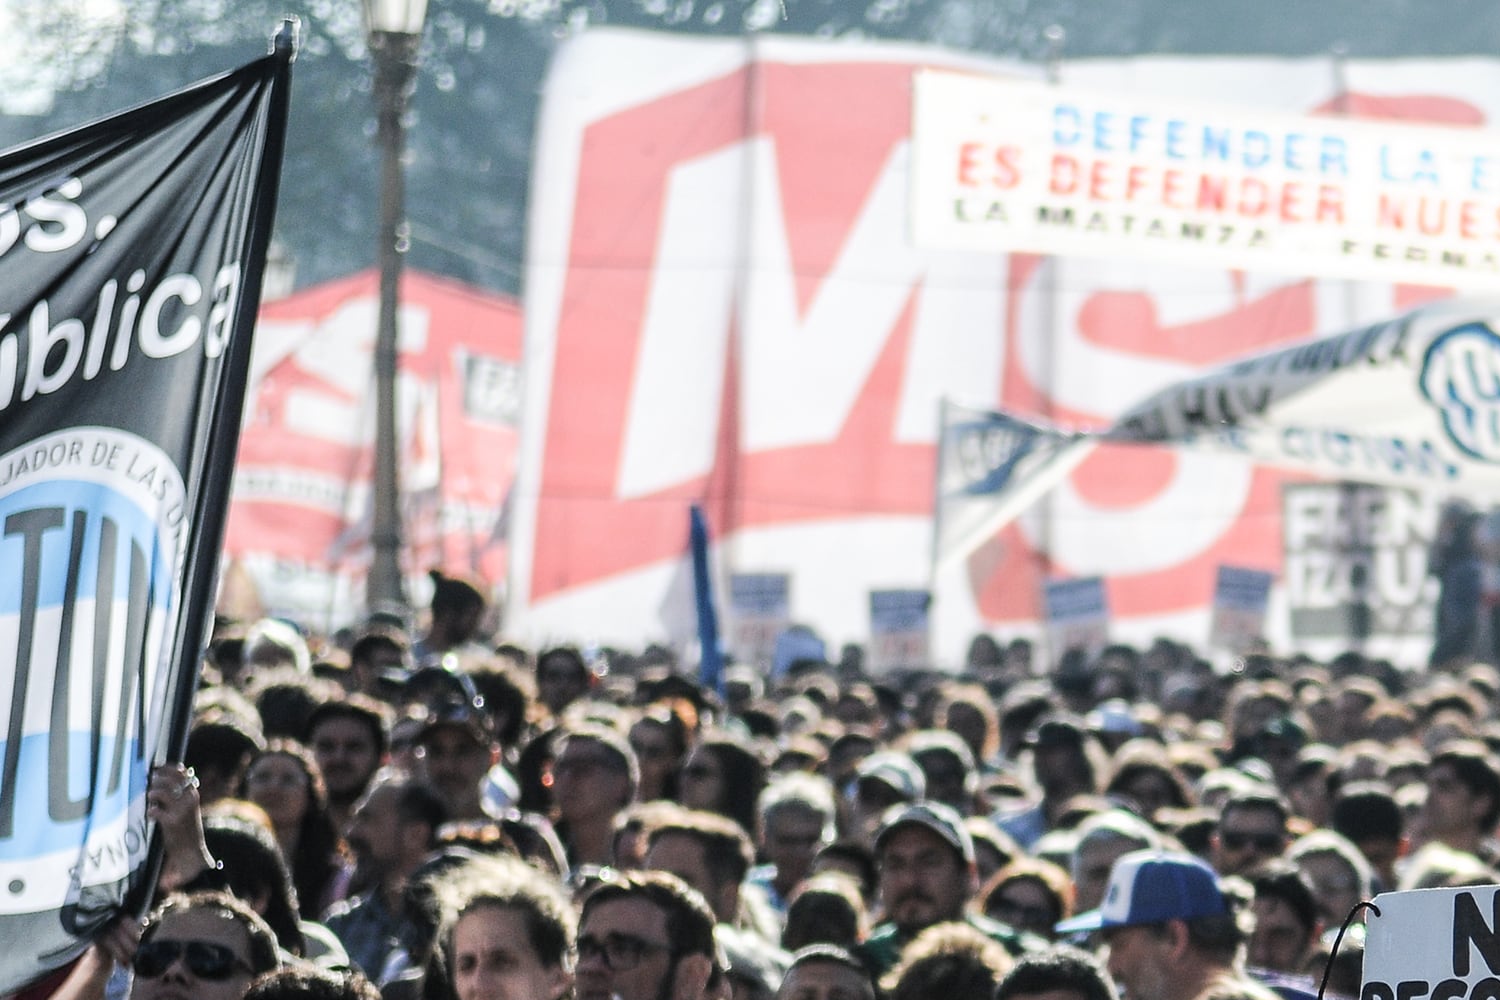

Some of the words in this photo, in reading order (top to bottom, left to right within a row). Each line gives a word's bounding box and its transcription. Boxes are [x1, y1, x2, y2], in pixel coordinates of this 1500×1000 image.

[1053, 105, 1347, 176] DEFENDER
[1379, 145, 1438, 185] LA
[954, 197, 1009, 225] LA
[955, 140, 1021, 189] ES
[1047, 152, 1345, 226] DEFENDER
[91, 441, 125, 471] DE
[125, 453, 174, 501] LAS
